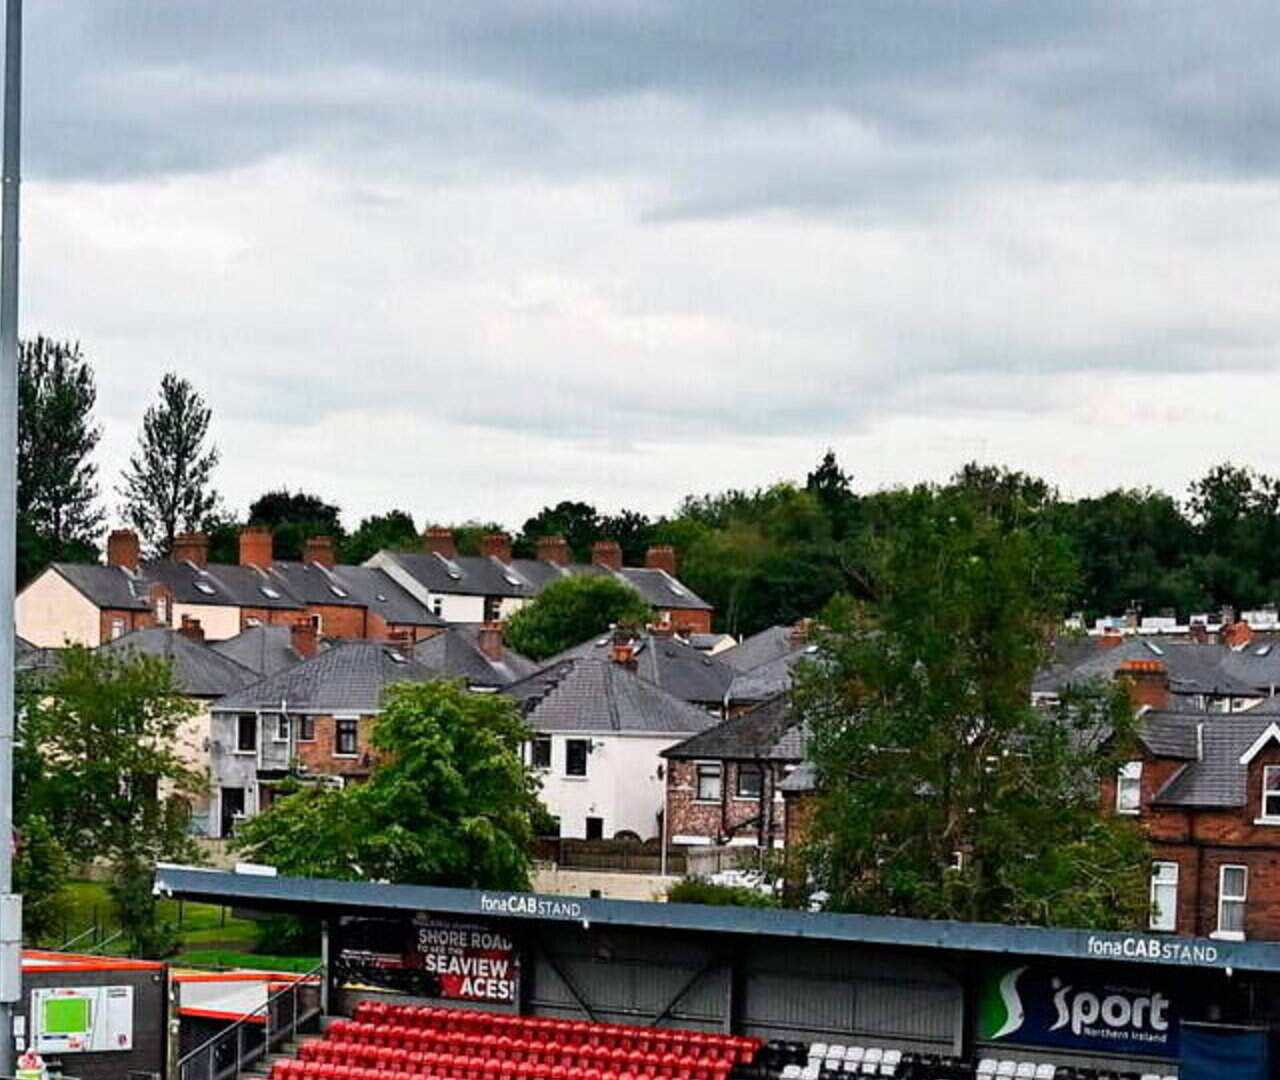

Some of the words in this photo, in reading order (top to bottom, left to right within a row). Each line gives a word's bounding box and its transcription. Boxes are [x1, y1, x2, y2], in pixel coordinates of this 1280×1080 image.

[419, 928, 467, 947] SHORE
[425, 954, 508, 979] SEAVIEW
[459, 978, 515, 1000] ACES!
[1083, 1027, 1129, 1041] Northern
[1131, 1030, 1167, 1044] Ireland
